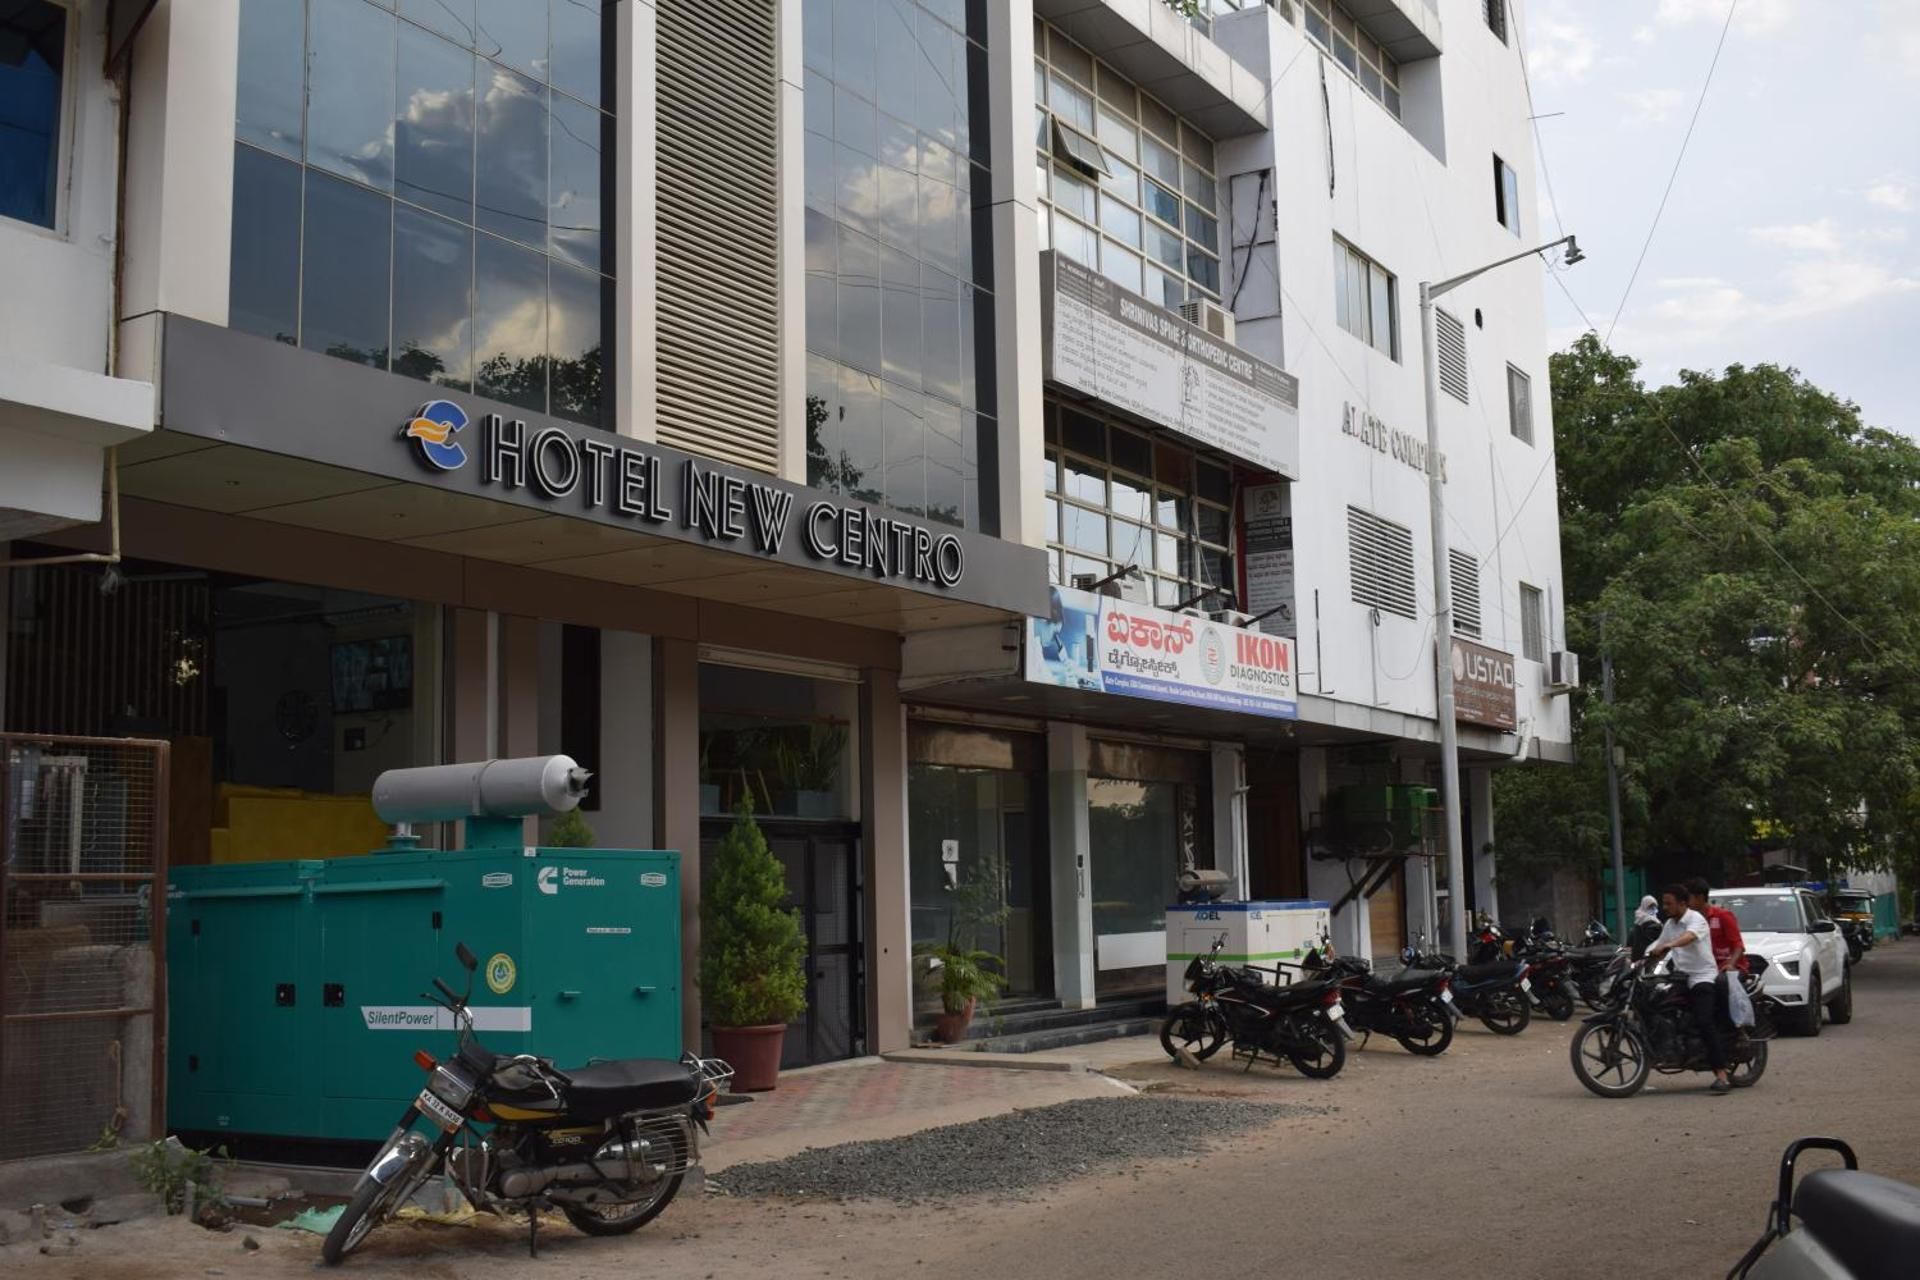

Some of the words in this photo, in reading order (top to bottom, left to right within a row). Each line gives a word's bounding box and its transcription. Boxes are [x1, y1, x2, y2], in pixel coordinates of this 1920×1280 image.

[1159, 318, 1180, 344] SPINE
[1228, 354, 1253, 380] CENTRE
[484, 413, 672, 523] HOTEL
[684, 459, 794, 554] NEW
[803, 501, 965, 588] CENTRO
[1236, 632, 1289, 673] IKON
[1230, 664, 1290, 687] DIAGNOSTICS
[1465, 651, 1514, 689] USTAD
[563, 867, 587, 876] Power
[563, 876, 605, 886] Generation
[368, 1011, 434, 1025] SilentPower
